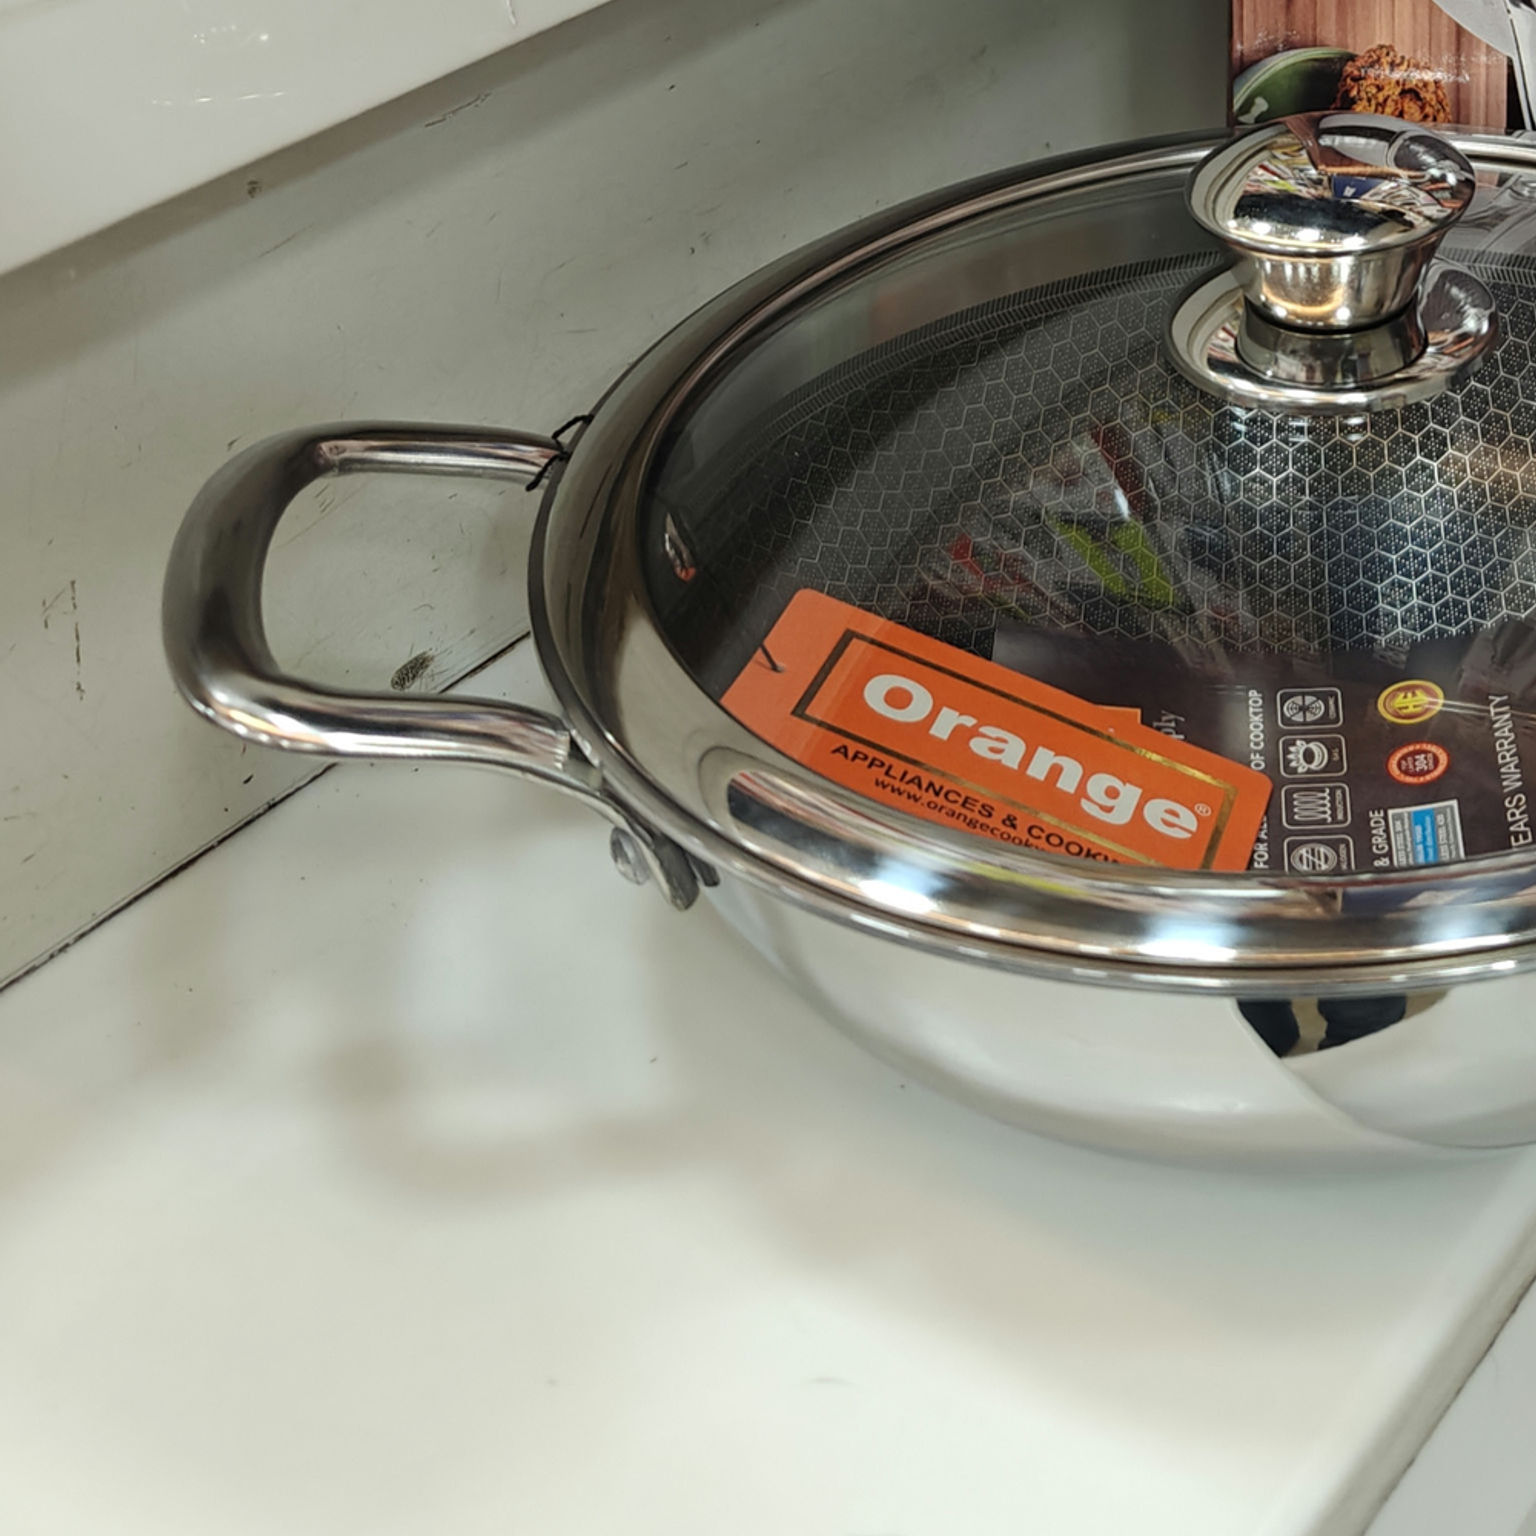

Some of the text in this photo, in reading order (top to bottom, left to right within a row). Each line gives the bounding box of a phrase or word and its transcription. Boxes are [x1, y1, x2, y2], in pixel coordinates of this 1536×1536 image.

[1248, 688, 1265, 752] COOKTOP
[831, 742, 994, 820] APPLIANCES
[862, 672, 1199, 841] Orange
[1250, 754, 1266, 771] OF
[1487, 694, 1533, 849] EARS WARRANTY
[1253, 842, 1269, 869] FOR
[1368, 809, 1389, 854] GRADE
